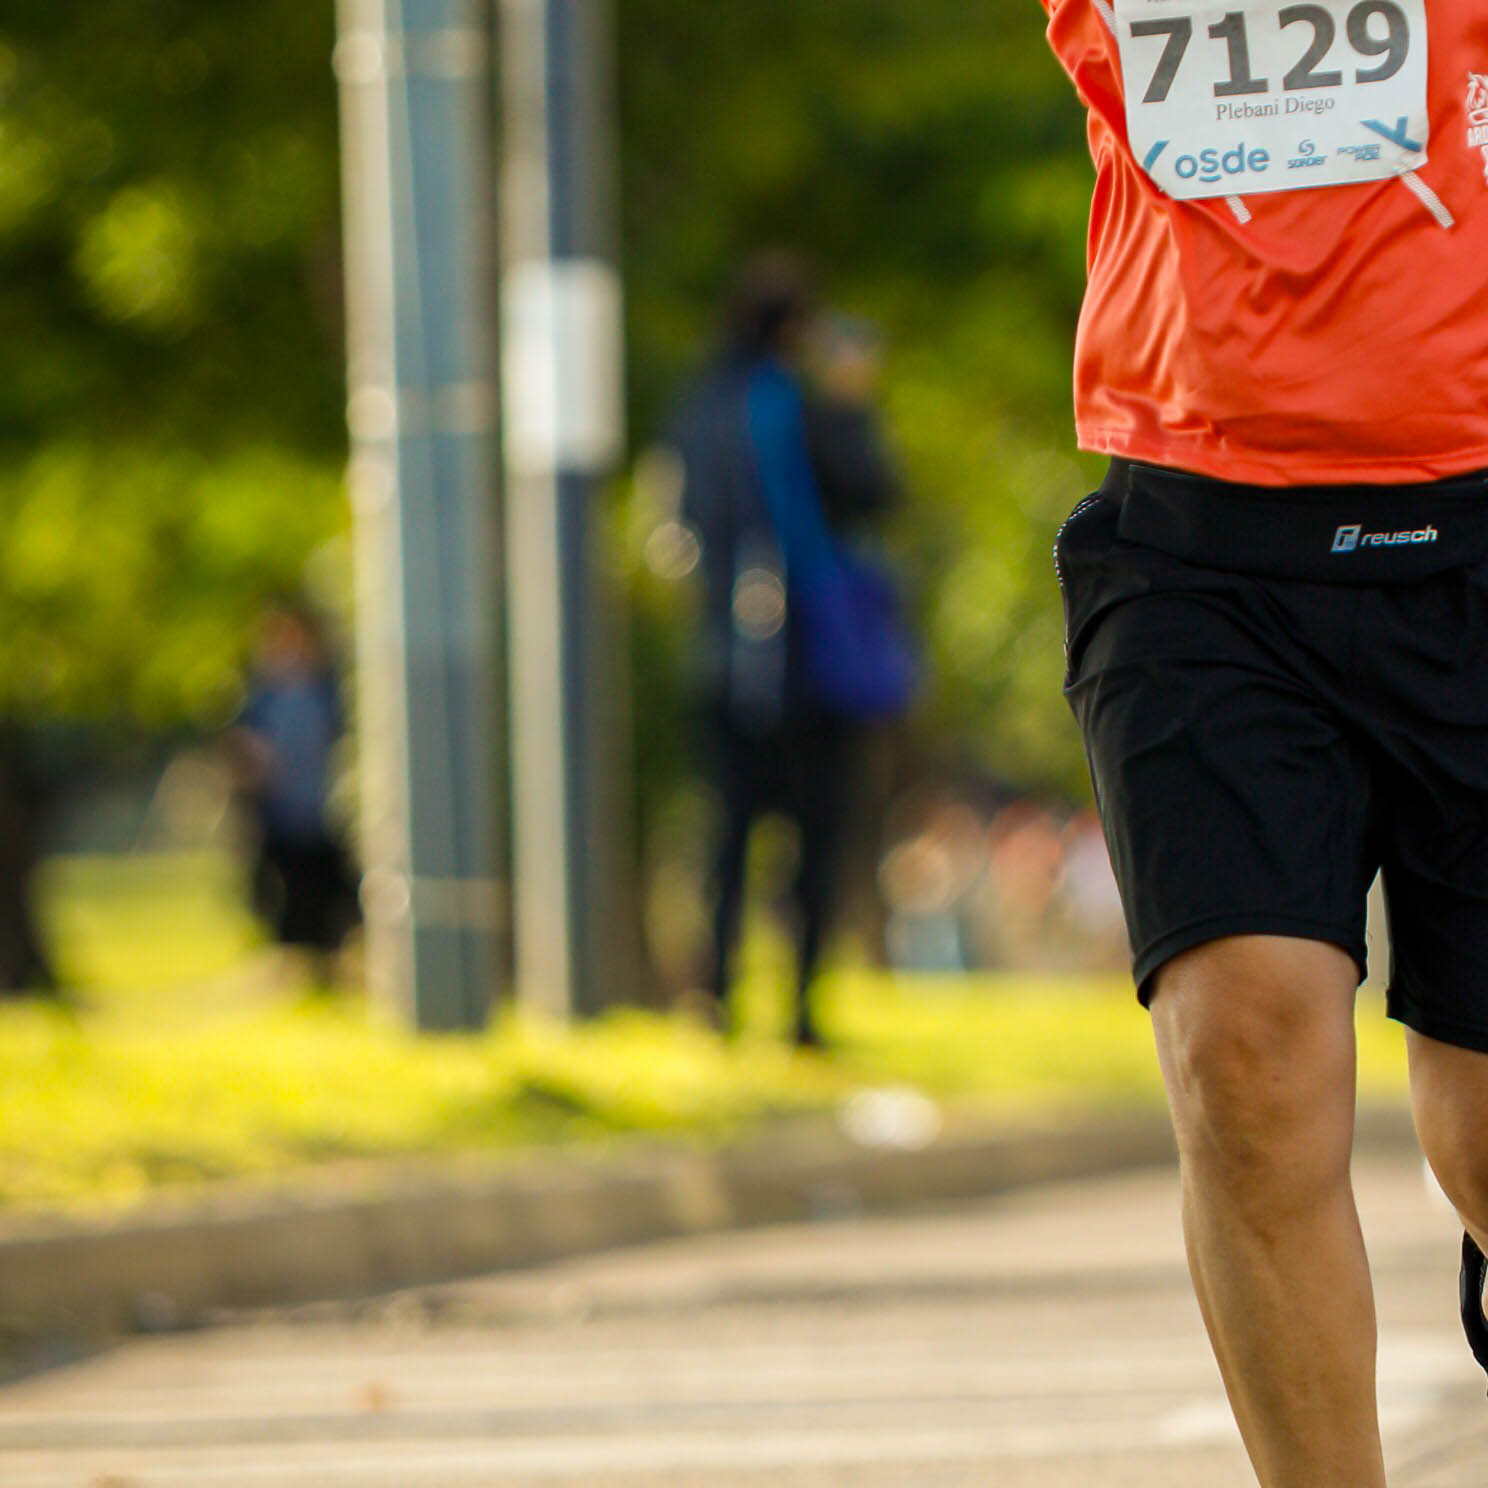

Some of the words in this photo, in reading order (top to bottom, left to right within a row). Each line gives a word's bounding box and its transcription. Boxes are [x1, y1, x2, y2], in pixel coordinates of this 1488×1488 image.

[1216, 99, 1279, 120] Plebani
[1285, 97, 1336, 115] Diego
[1174, 141, 1271, 182] osde
[1360, 524, 1439, 546] reusch
